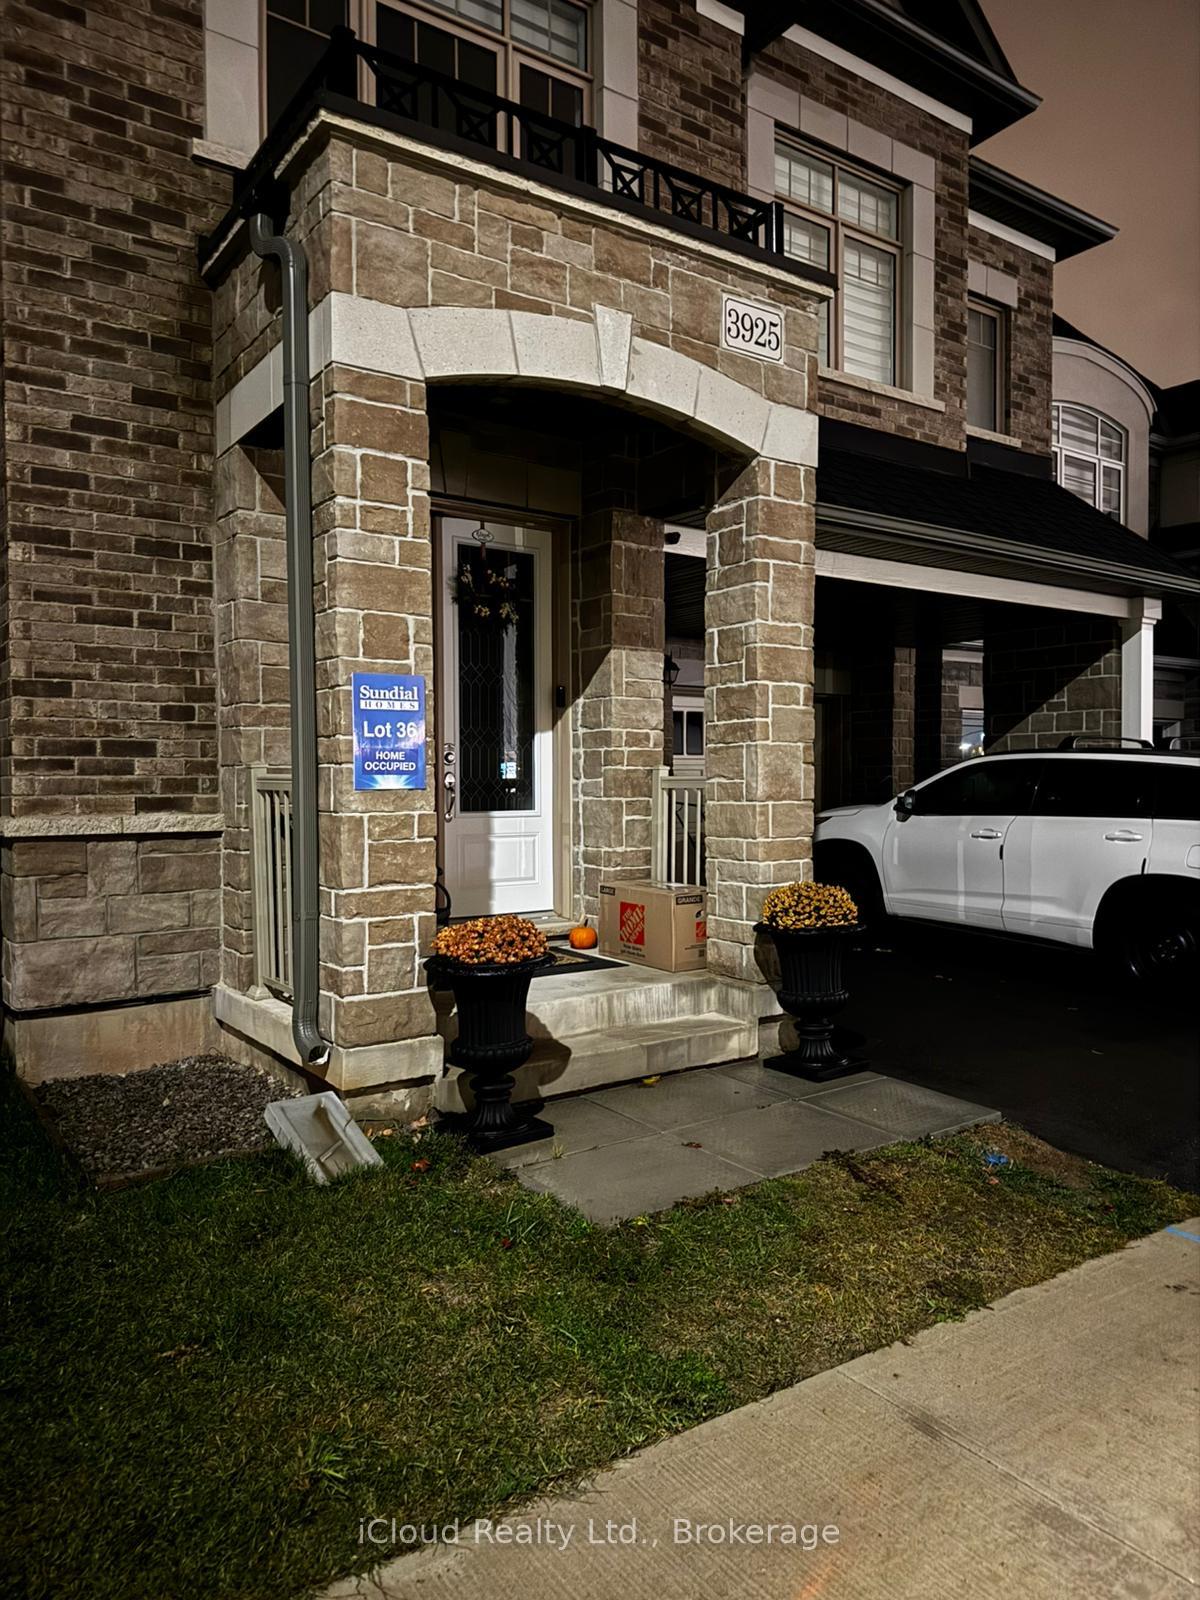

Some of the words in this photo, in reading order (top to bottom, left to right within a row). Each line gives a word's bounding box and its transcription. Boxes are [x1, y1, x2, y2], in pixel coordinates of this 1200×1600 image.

[727, 308, 780, 351] 3925
[360, 685, 419, 700] Sundial
[364, 701, 416, 709] HOMES
[363, 721, 392, 738] Lot
[396, 722, 418, 738] 36
[375, 751, 406, 760] HOME
[364, 762, 416, 771] OCCUPIED
[620, 907, 644, 942] HOME
